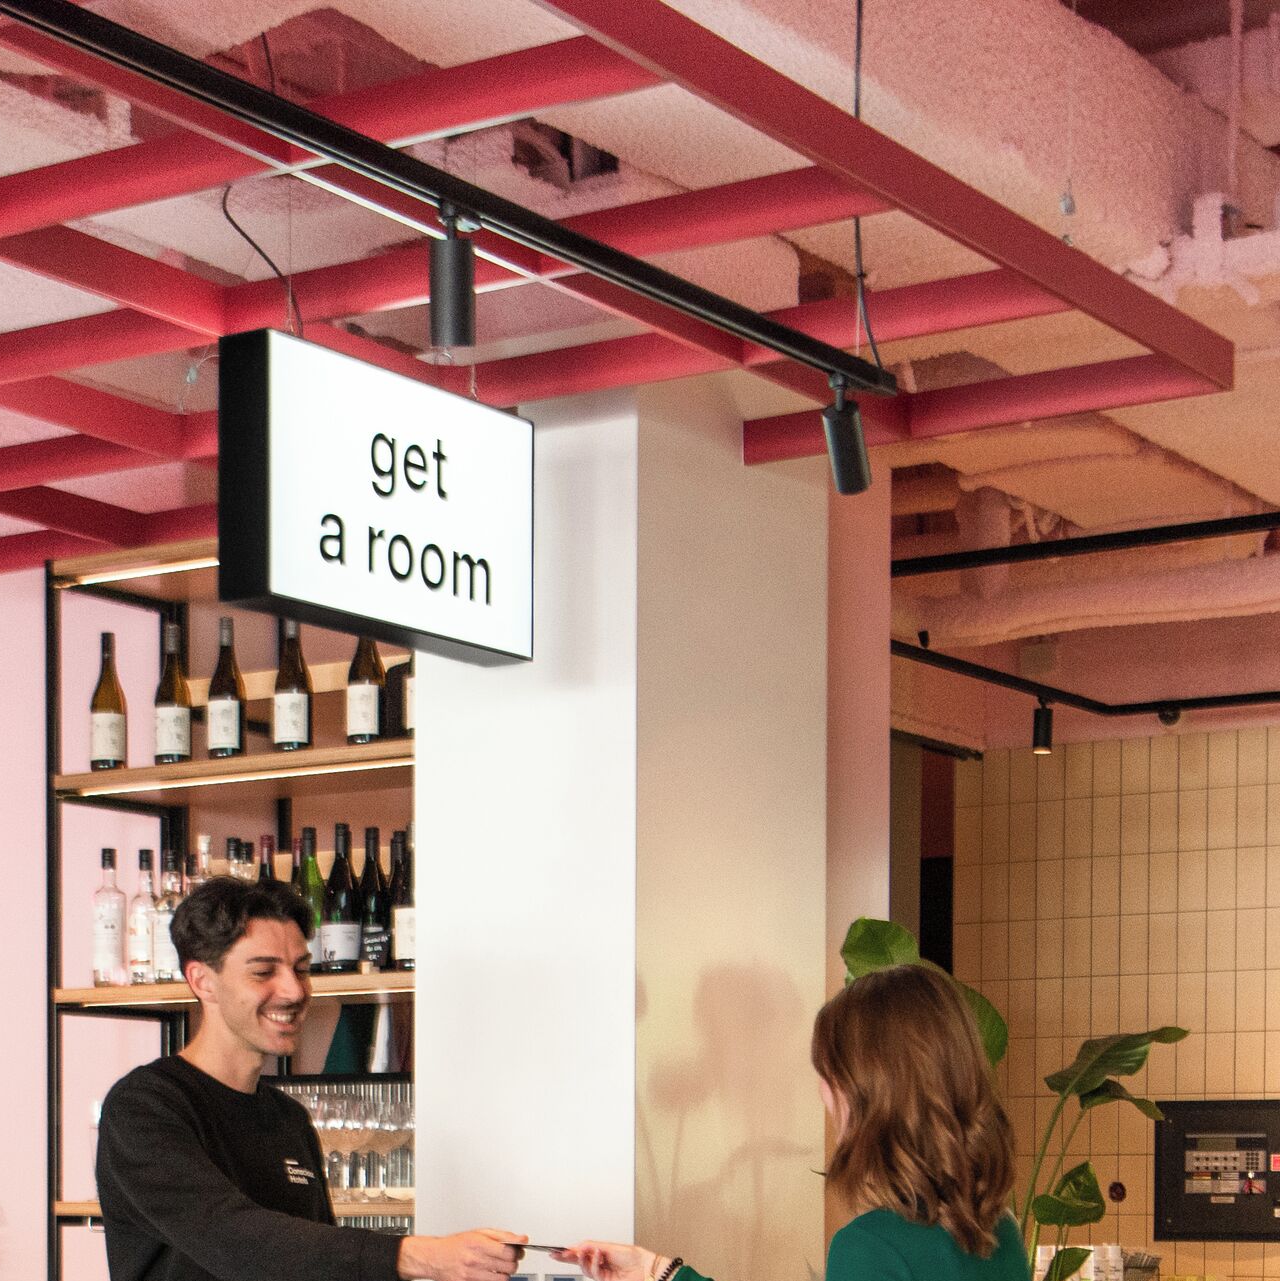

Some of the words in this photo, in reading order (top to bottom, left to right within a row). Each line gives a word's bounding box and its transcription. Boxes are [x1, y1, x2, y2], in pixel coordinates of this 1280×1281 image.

[370, 432, 448, 500] get
[319, 513, 347, 566] a
[368, 526, 492, 606] room
